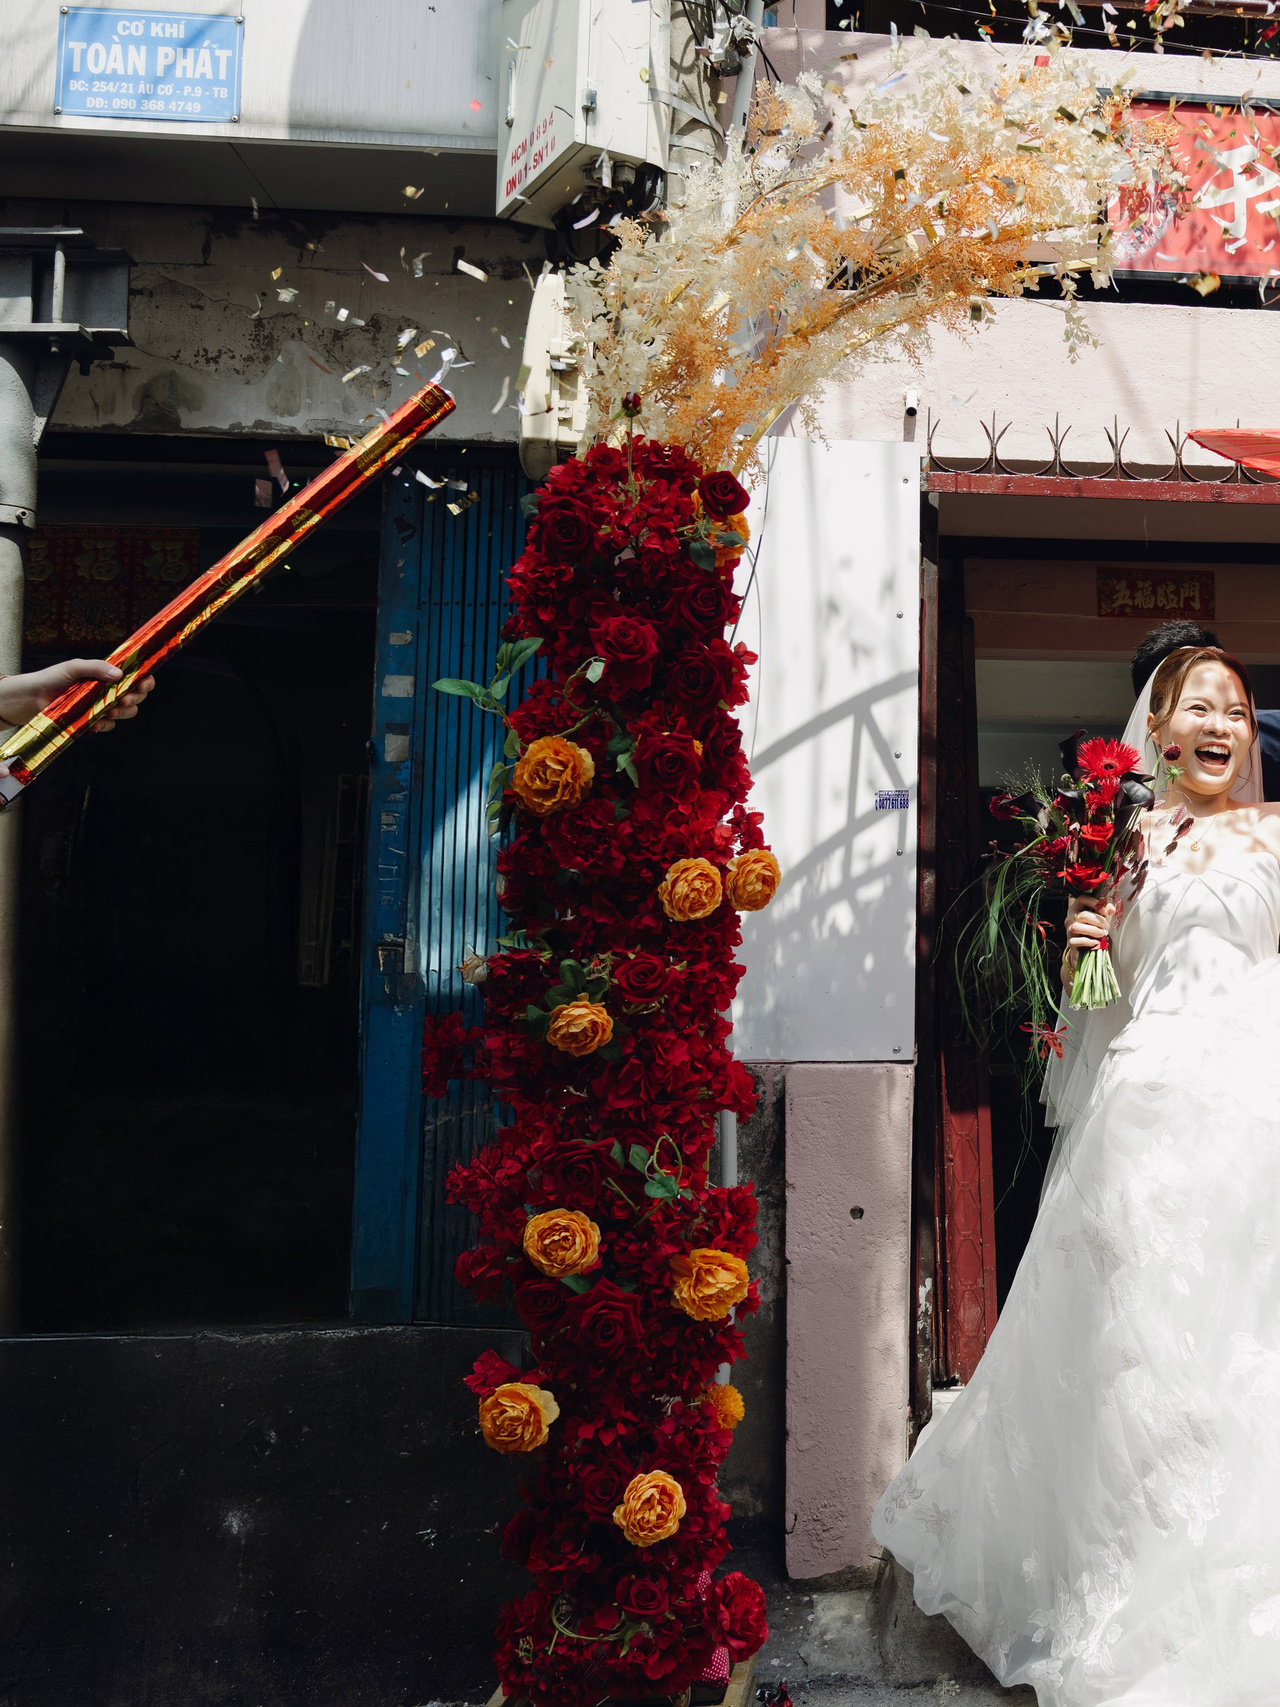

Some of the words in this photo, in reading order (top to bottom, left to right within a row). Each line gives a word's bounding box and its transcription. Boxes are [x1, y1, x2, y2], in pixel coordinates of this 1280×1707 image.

[117, 20, 145, 36] CƠ
[151, 20, 186, 38] KHÍ
[68, 35, 146, 76] TOÀN
[156, 40, 233, 80] PHÁT
[69, 80, 89, 92] ĐC:
[92, 80, 134, 94] 254/21
[138, 81, 154, 95] ÂU
[157, 84, 174, 96] CƠ
[183, 86, 202, 97] P.9
[212, 87, 228, 98] TB
[112, 98, 137, 110] 090
[141, 99, 164, 111] 368
[168, 100, 202, 113] 4749
[511, 138, 527, 167] HCM
